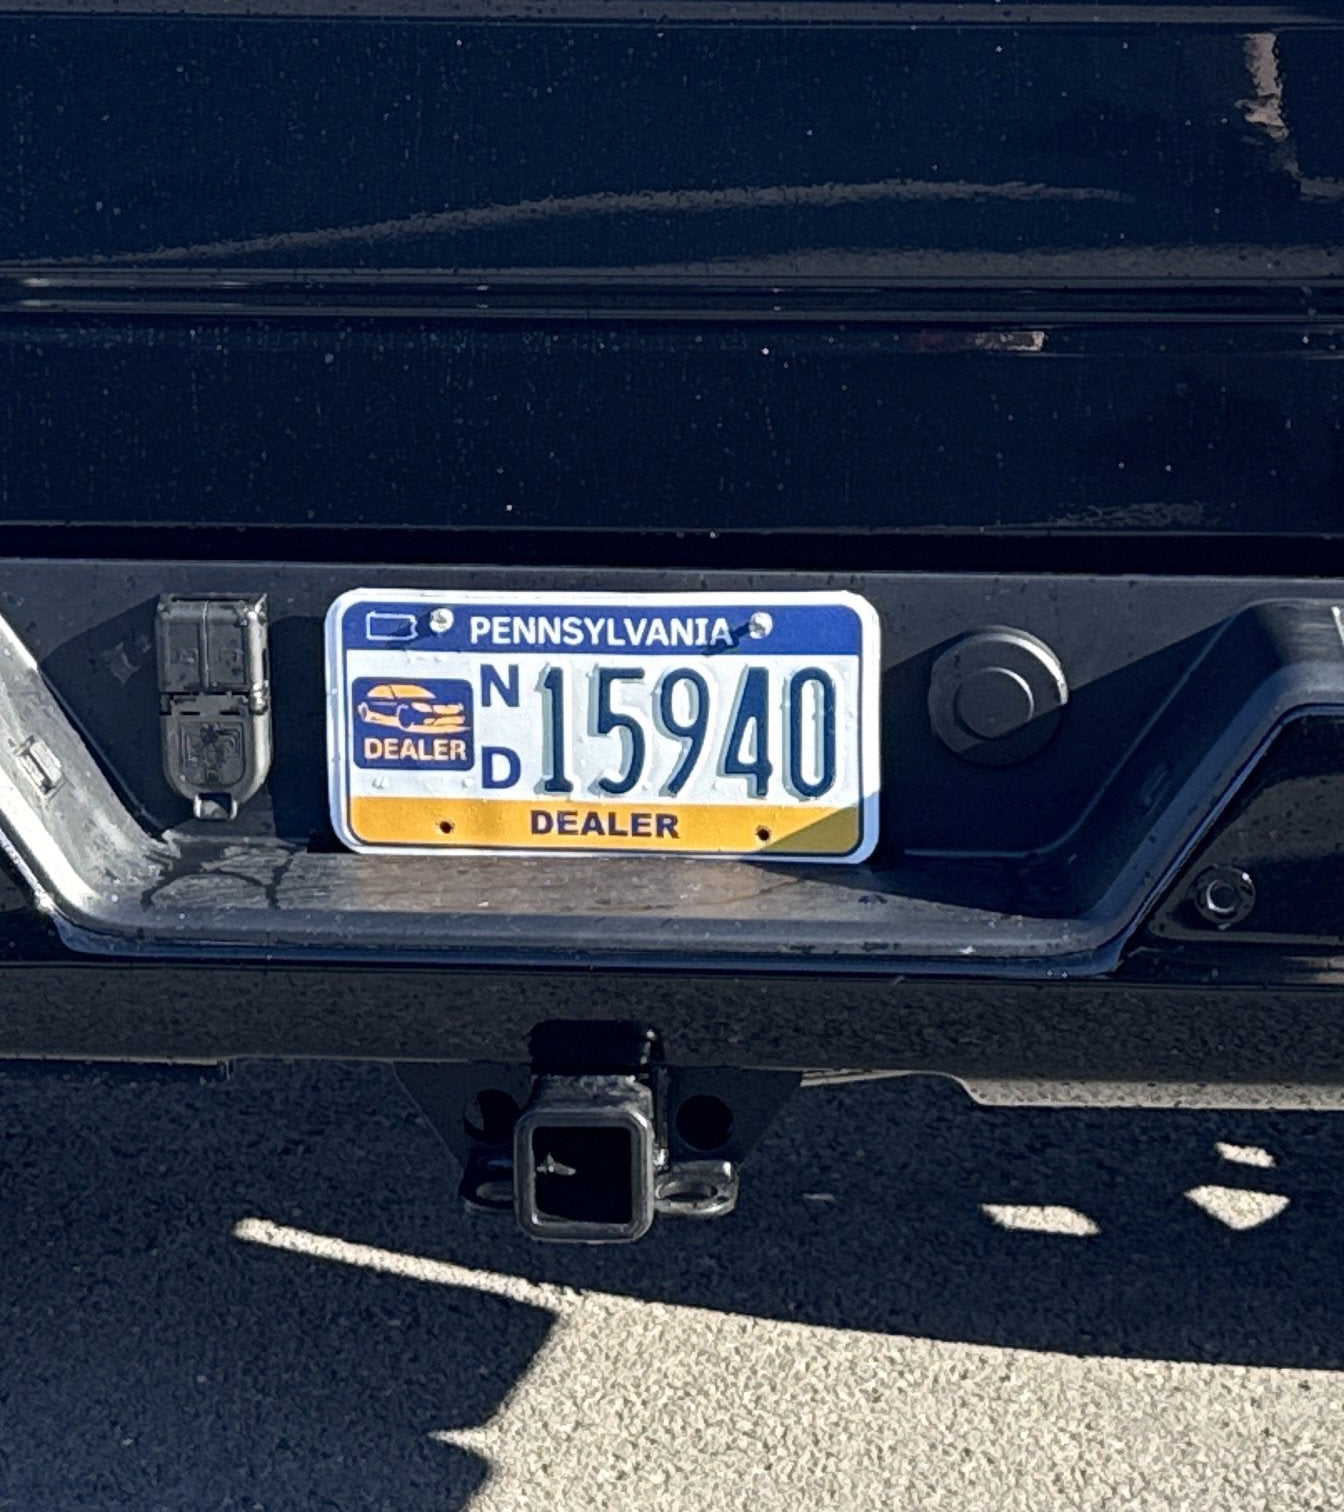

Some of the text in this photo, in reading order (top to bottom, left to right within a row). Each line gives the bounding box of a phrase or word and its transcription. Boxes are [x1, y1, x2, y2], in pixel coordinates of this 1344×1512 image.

[469, 615, 734, 647] PENNSYLVANIA
[480, 663, 520, 708] N
[363, 737, 467, 762] DEALER
[536, 665, 838, 798] 15940
[481, 745, 522, 790] D
[529, 808, 680, 839] DEALER
